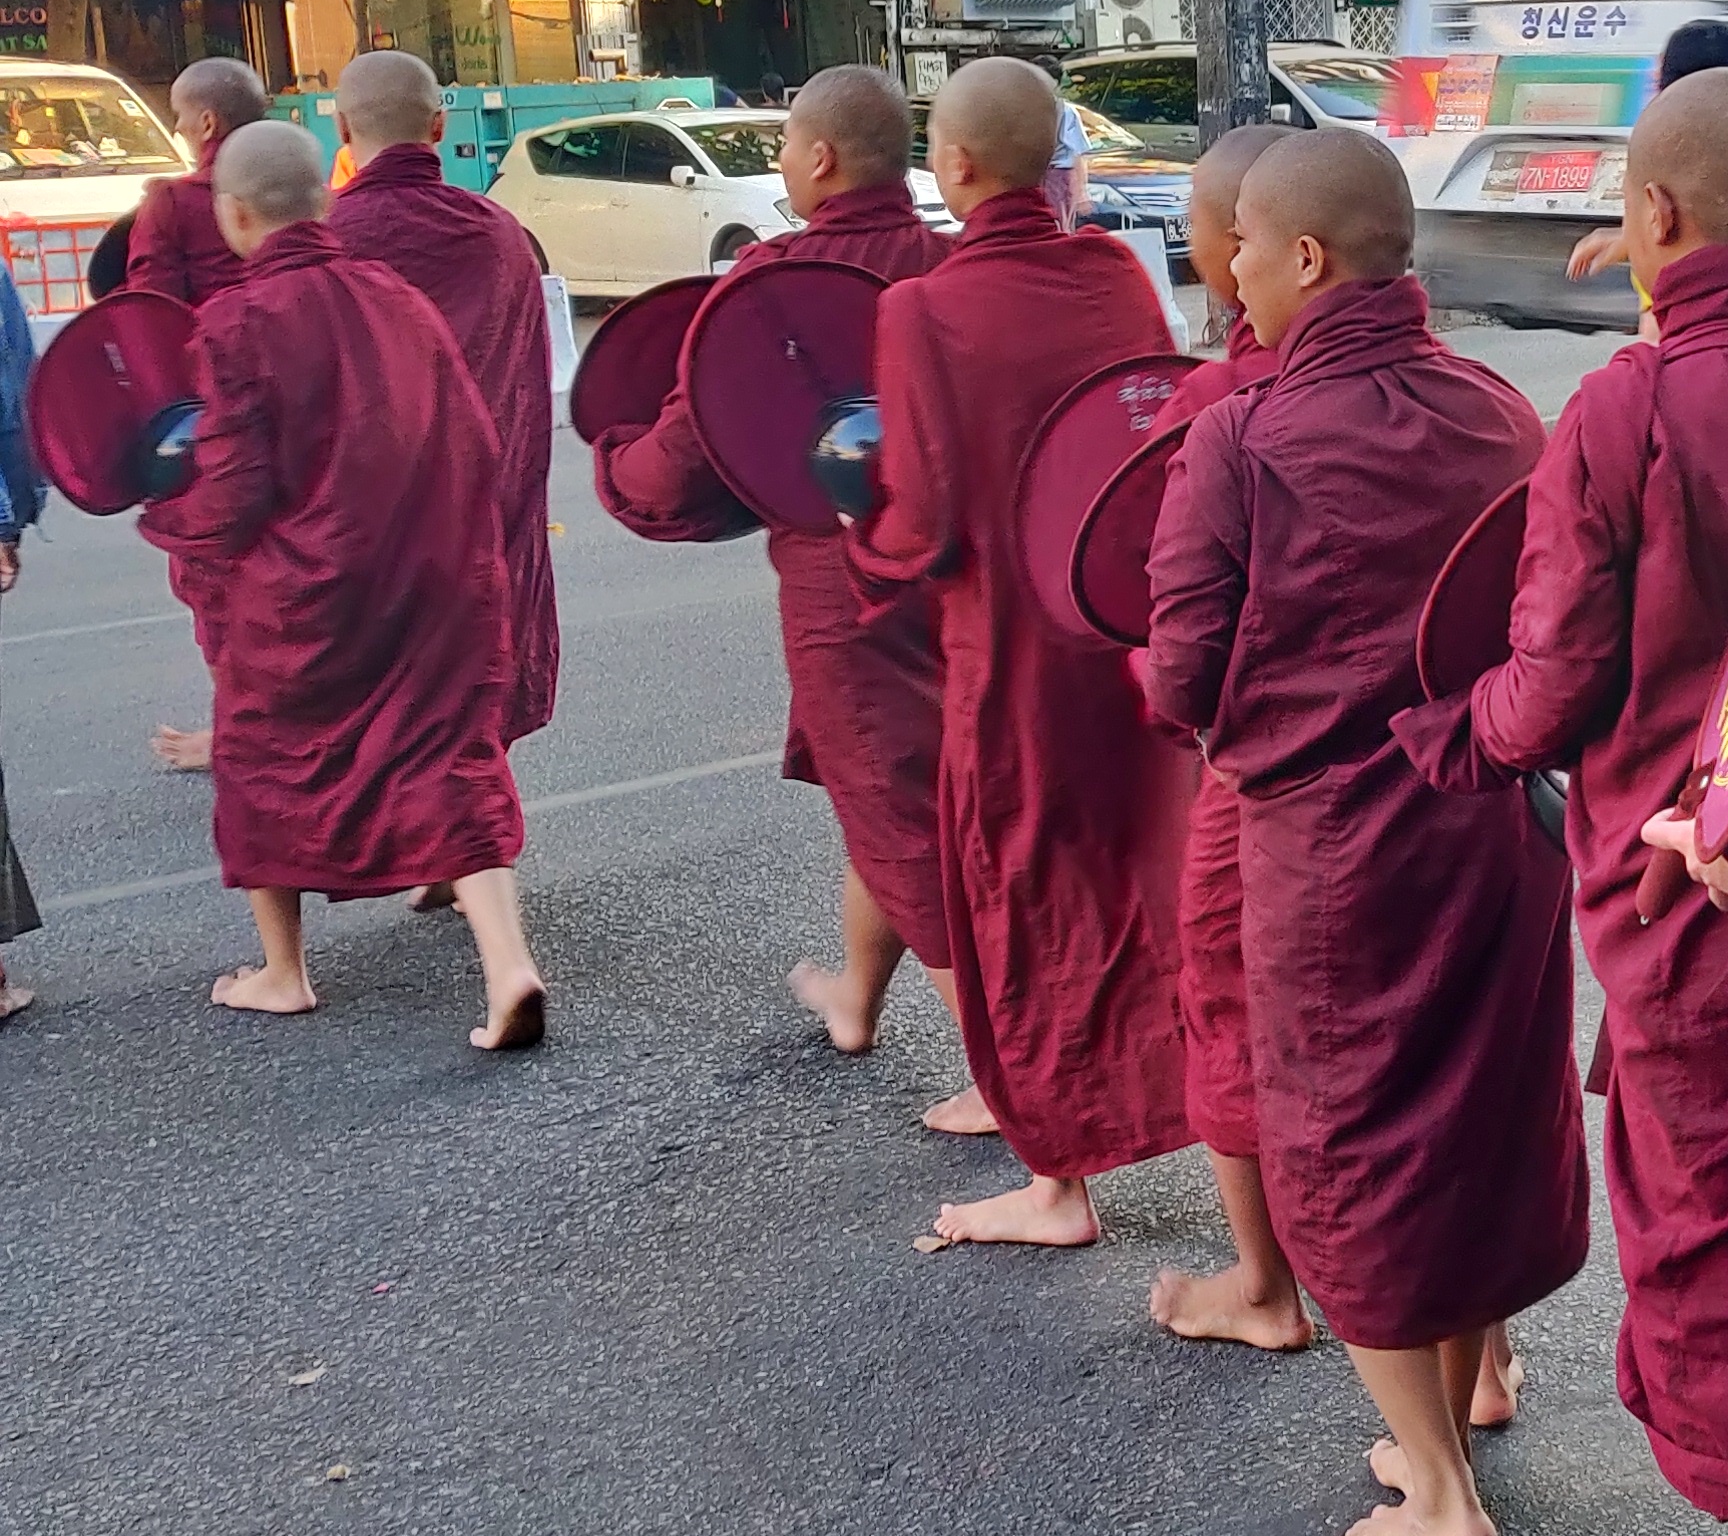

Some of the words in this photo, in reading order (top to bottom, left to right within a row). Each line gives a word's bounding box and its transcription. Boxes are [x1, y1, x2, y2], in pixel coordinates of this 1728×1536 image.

[1521, 5, 1627, 40] 청신운수
[1550, 154, 1575, 164] YGN
[1522, 167, 1590, 189] 7N-1899
